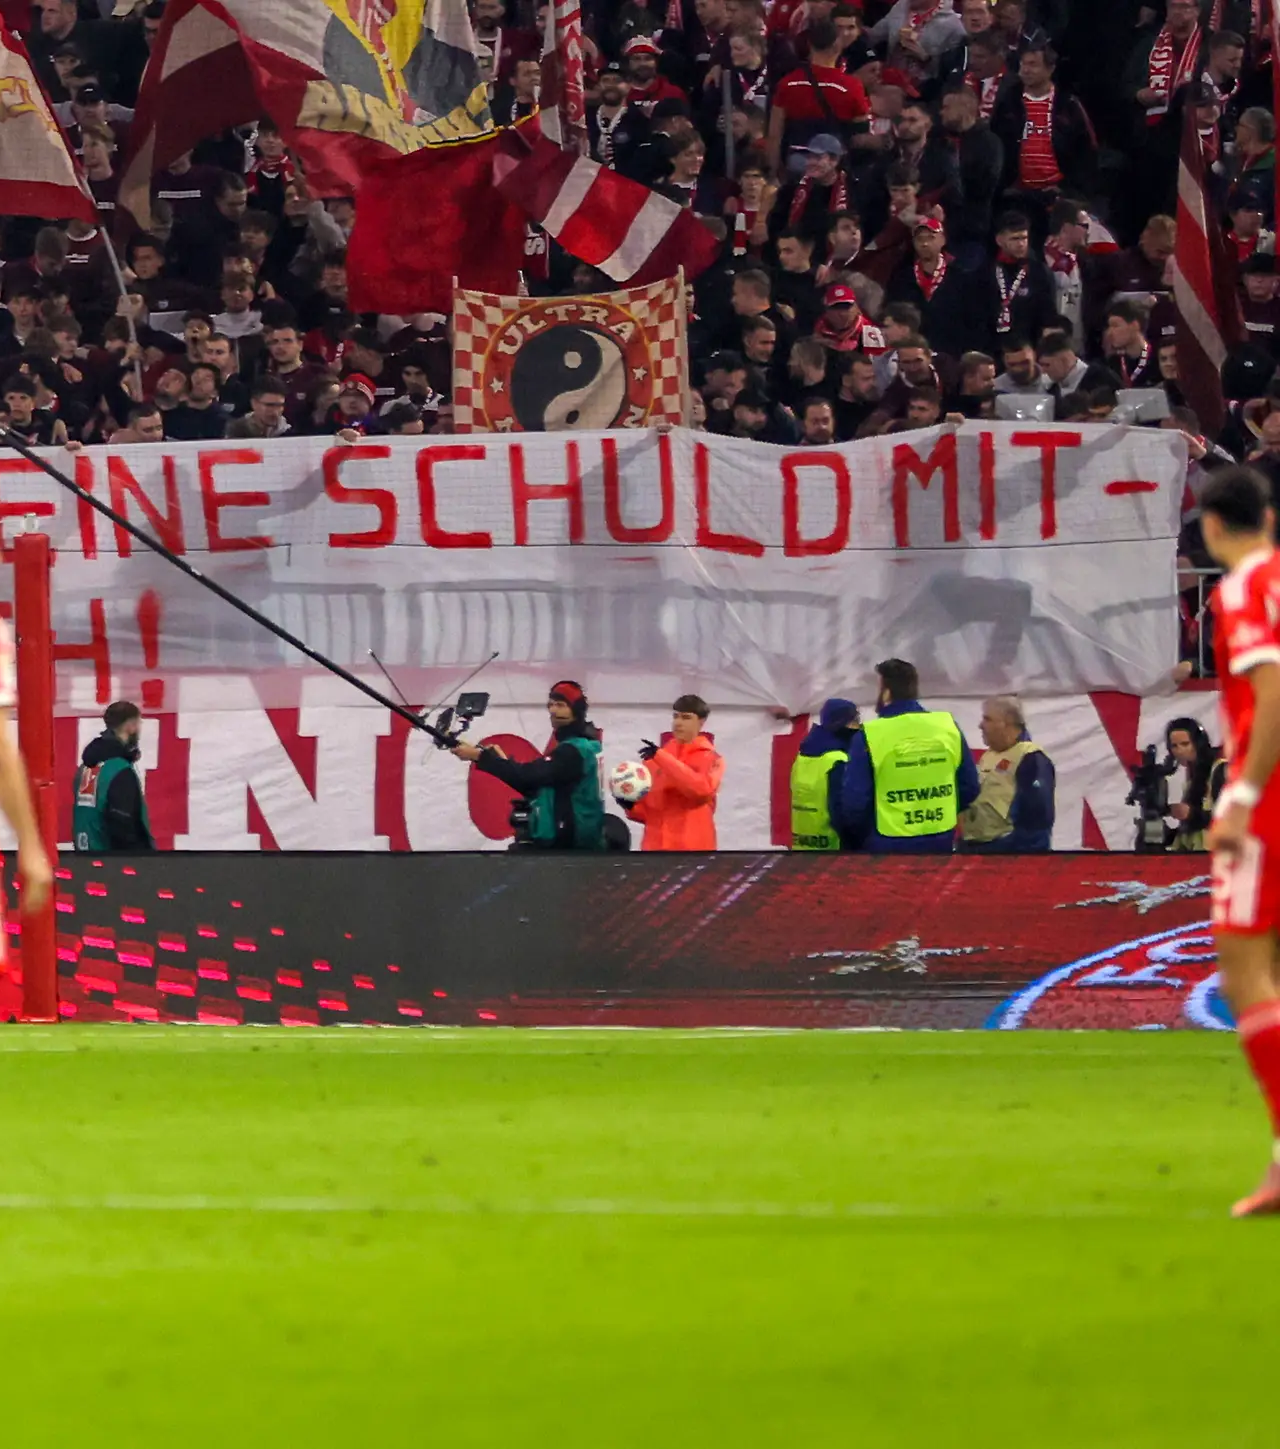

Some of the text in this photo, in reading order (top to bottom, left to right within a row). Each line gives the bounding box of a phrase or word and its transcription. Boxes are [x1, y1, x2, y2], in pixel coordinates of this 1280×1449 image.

[497, 303, 636, 356] ULTRA
[323, 434, 851, 557] SCHULD
[886, 783, 954, 804] STEWARD
[904, 807, 944, 826] 1545
